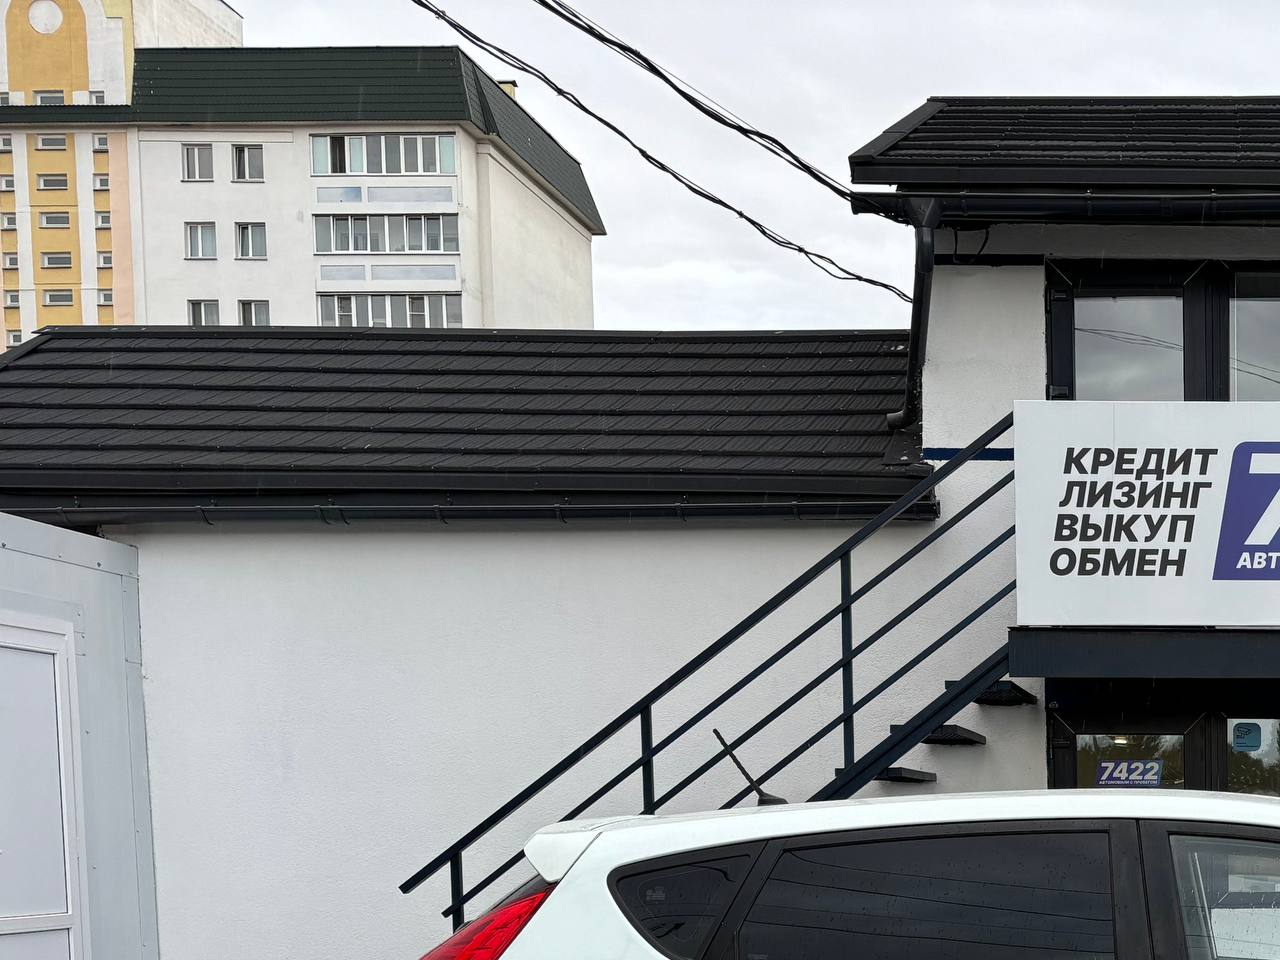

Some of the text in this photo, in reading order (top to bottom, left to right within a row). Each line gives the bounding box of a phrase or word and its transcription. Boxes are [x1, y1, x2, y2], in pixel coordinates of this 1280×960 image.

[1063, 447, 1219, 481] КРЕДИТ
[1058, 480, 1213, 509] ЛИЗИНГ
[1053, 513, 1196, 543] ВЫКУП
[1049, 547, 1188, 577] ОБМЕН
[1100, 762, 1159, 780] 7422
